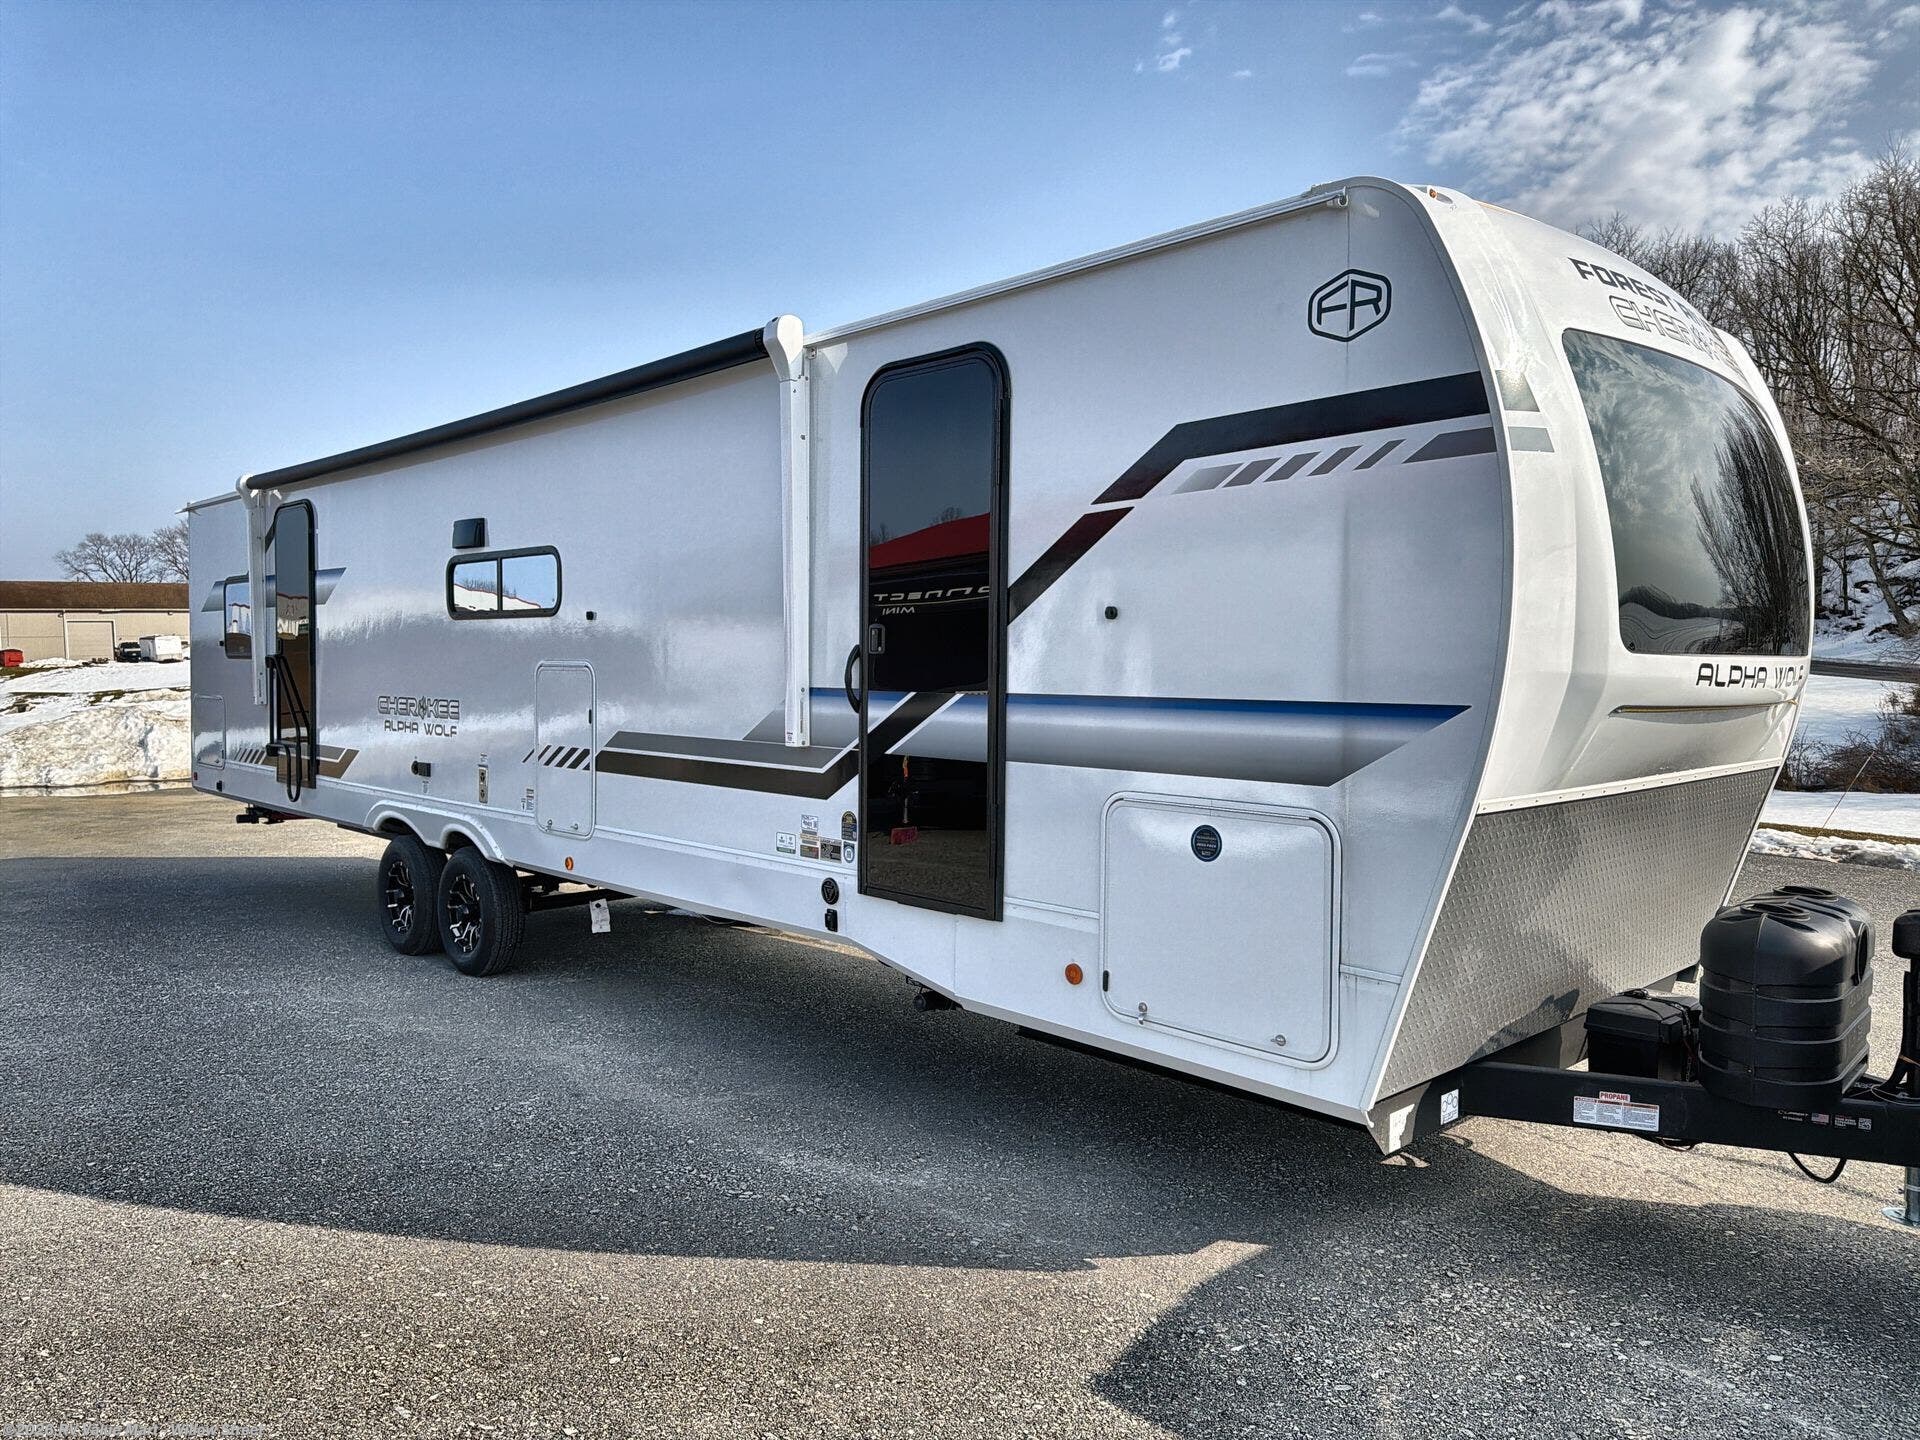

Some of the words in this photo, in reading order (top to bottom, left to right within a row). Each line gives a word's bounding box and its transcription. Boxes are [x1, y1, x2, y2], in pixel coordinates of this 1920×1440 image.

[1568, 257, 1677, 311] FOREST
[1695, 662, 1768, 689] ALPHA
[1774, 664, 1804, 689] WOLF
[377, 695, 460, 720] CHEROKEE
[384, 720, 419, 734] ALPHA
[423, 722, 457, 738] WOLF
